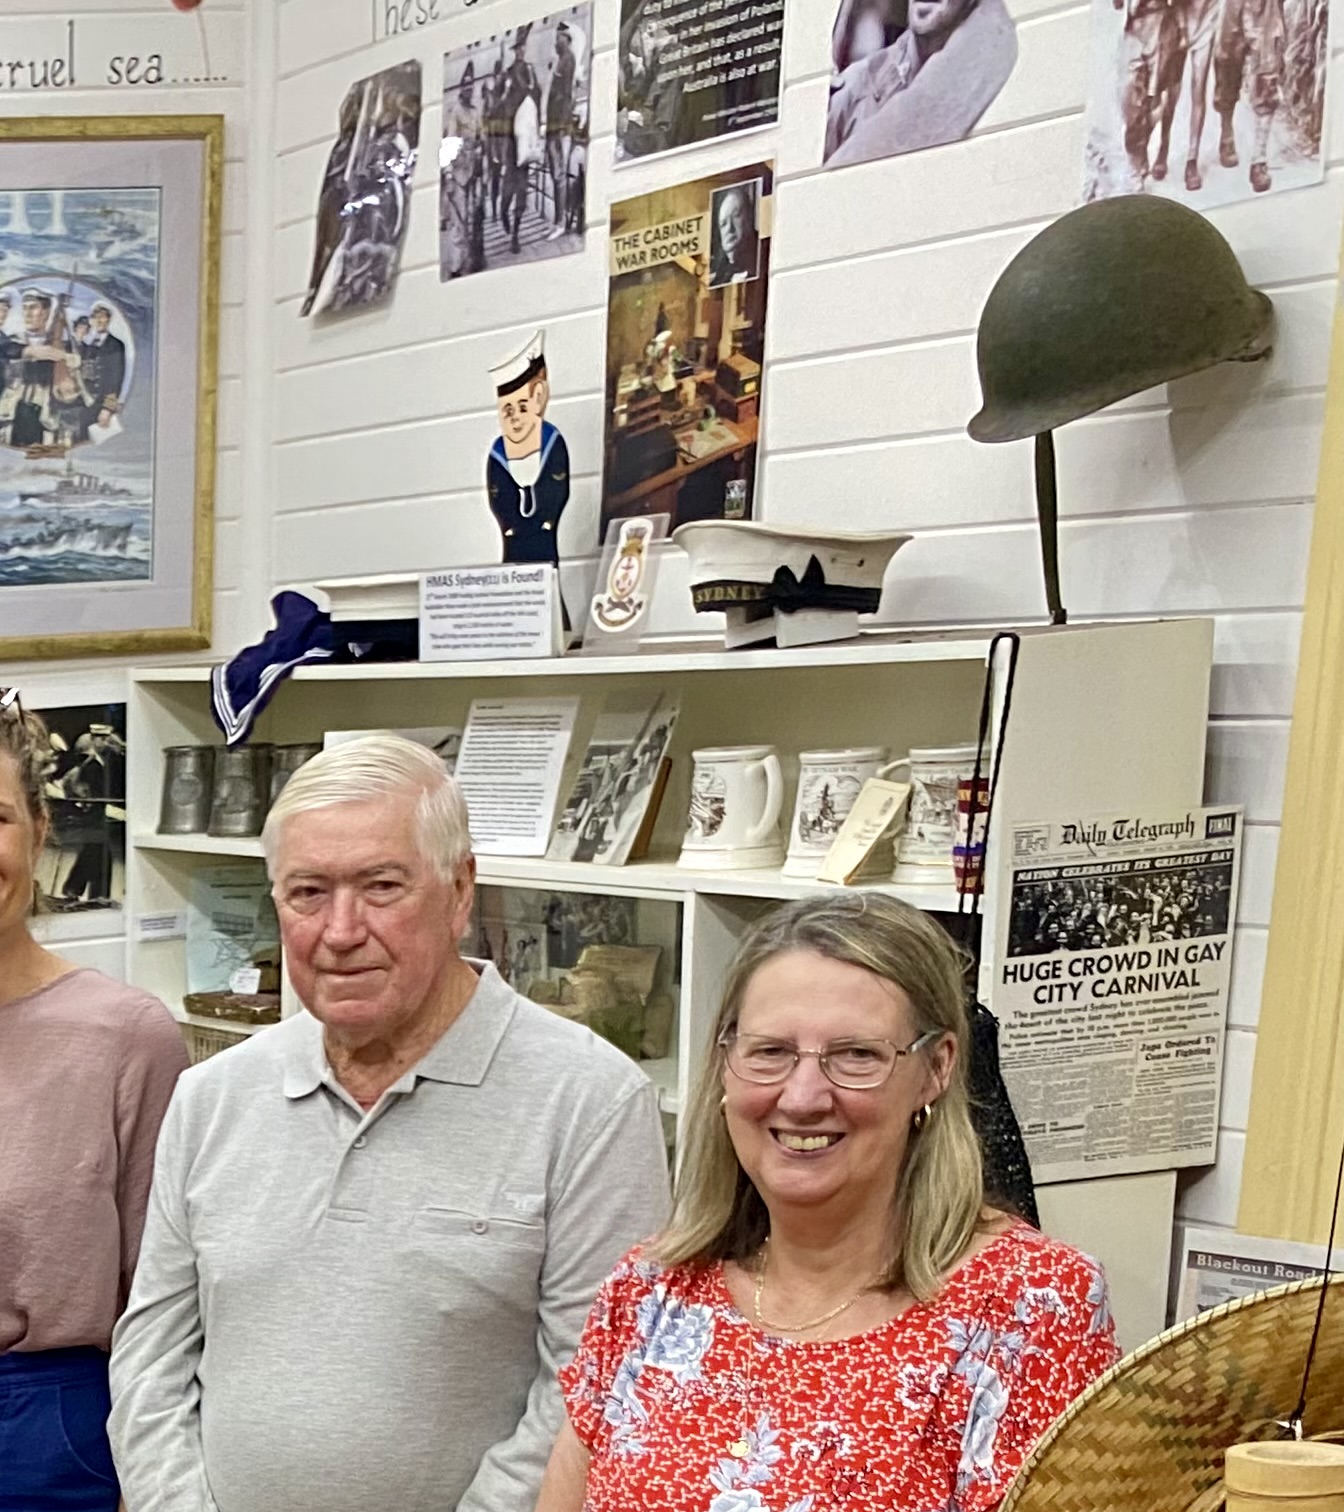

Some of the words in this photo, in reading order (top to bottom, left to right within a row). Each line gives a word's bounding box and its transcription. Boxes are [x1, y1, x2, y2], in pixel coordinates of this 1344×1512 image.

[613, 231, 639, 253] THE
[642, 215, 703, 245] CABINET
[615, 250, 646, 270] WAR
[650, 237, 699, 261] ROOMS
[1061, 823, 1107, 846] Daily
[1112, 812, 1196, 841] Telegraph
[1002, 960, 1062, 984] HUGE
[1068, 951, 1151, 977] CROWD
[1157, 947, 1179, 967] IN
[1184, 941, 1226, 963] GAY
[1033, 981, 1083, 1004] CITY
[1091, 968, 1200, 998] CARNIVAL
[1197, 1254, 1268, 1275] Blackout
